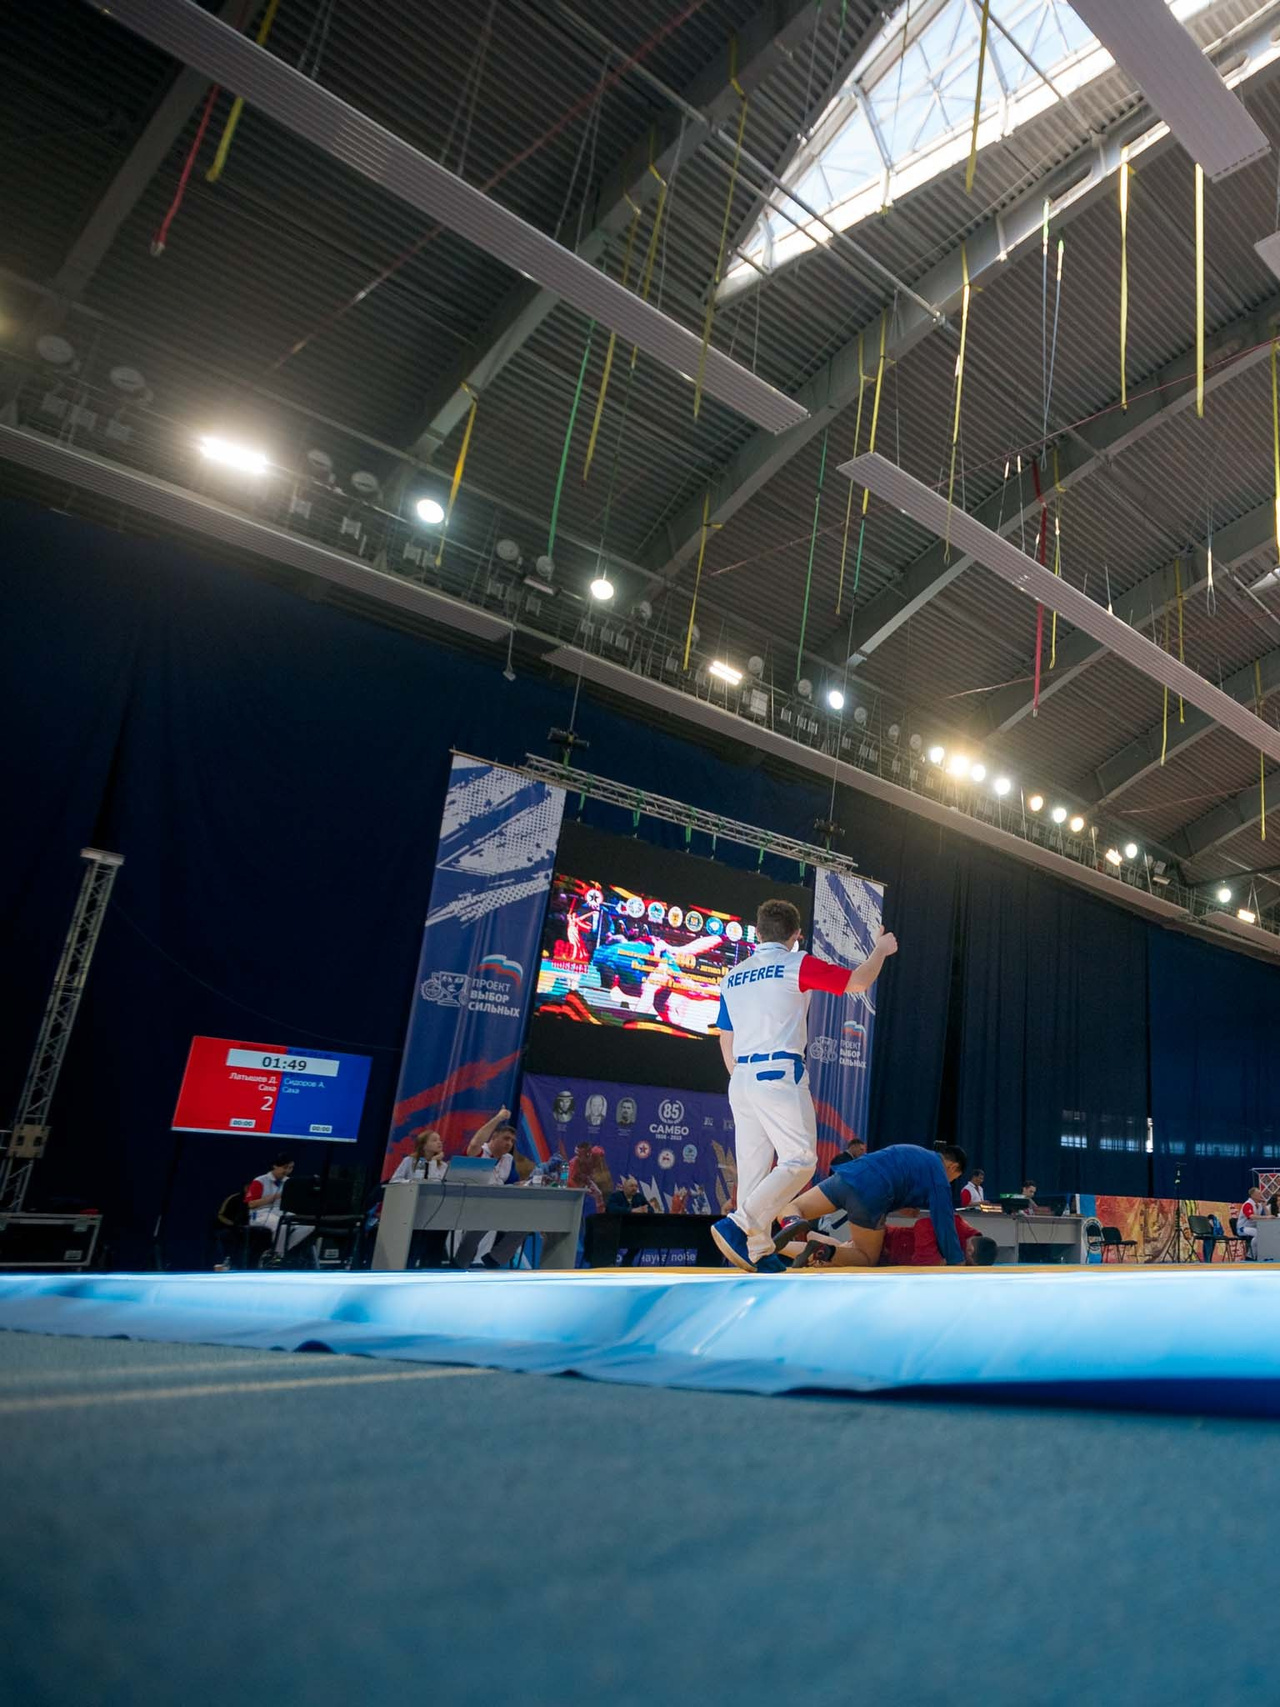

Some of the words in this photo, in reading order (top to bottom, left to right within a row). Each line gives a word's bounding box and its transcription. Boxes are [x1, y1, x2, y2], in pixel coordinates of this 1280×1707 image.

[727, 965, 785, 989] REFEREE
[472, 979, 511, 992] ПРОЕКТ
[470, 990, 509, 1003] ВЫБОР
[468, 1001, 520, 1018] СИЛЬНЫХ
[262, 1056, 307, 1071] 01:49
[260, 1096, 274, 1111] 2
[663, 1103, 680, 1119] 85
[649, 1124, 690, 1136] САМБО
